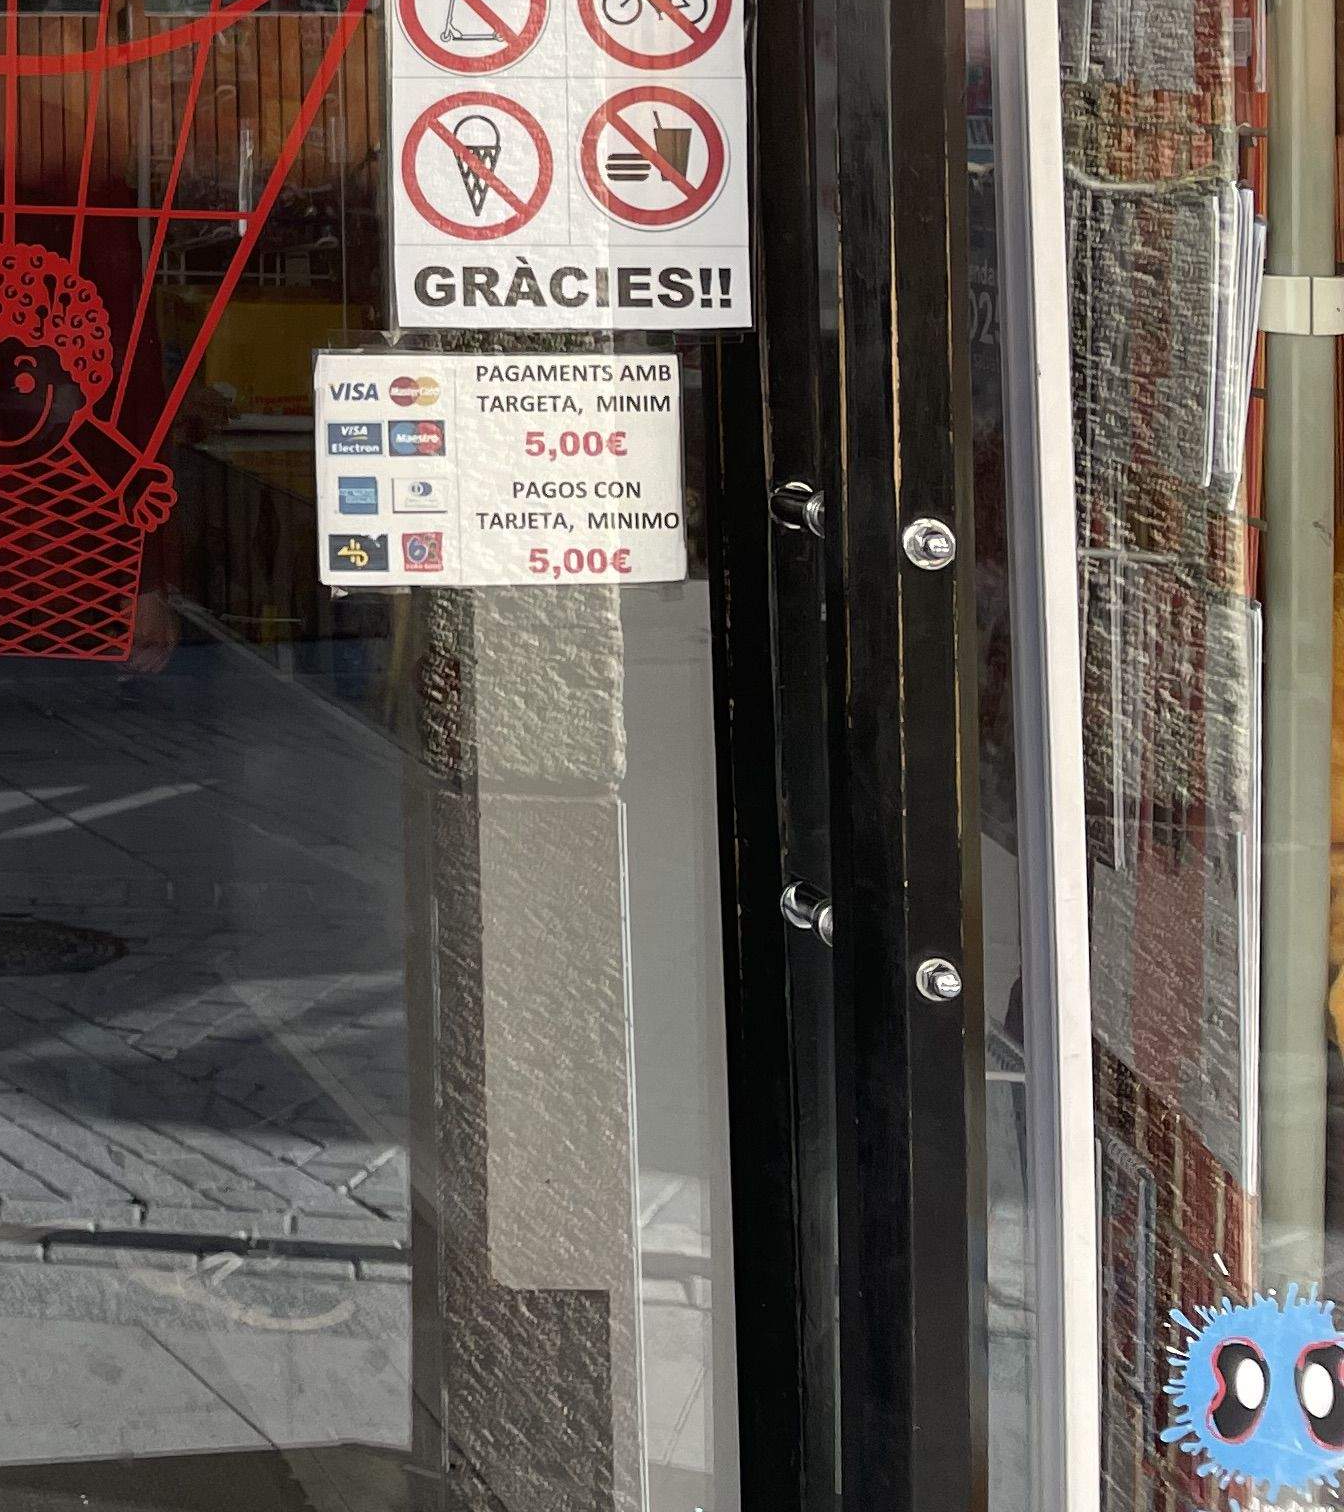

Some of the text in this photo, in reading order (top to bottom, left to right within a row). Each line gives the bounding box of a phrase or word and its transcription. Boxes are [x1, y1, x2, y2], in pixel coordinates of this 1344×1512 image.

[413, 256, 733, 309] GRÀCIES!!
[476, 364, 672, 383] PAGAMENTS AMB
[329, 382, 379, 402] VISA
[476, 394, 672, 416] TARGETA, MINIM
[341, 426, 368, 437] VISA
[331, 432, 440, 454] Electron Maestro
[524, 431, 629, 462] 5,00€
[512, 481, 641, 500] PAGOS CON
[476, 511, 680, 534] TARJETA, MINIMO
[528, 548, 633, 580] 5,00€
